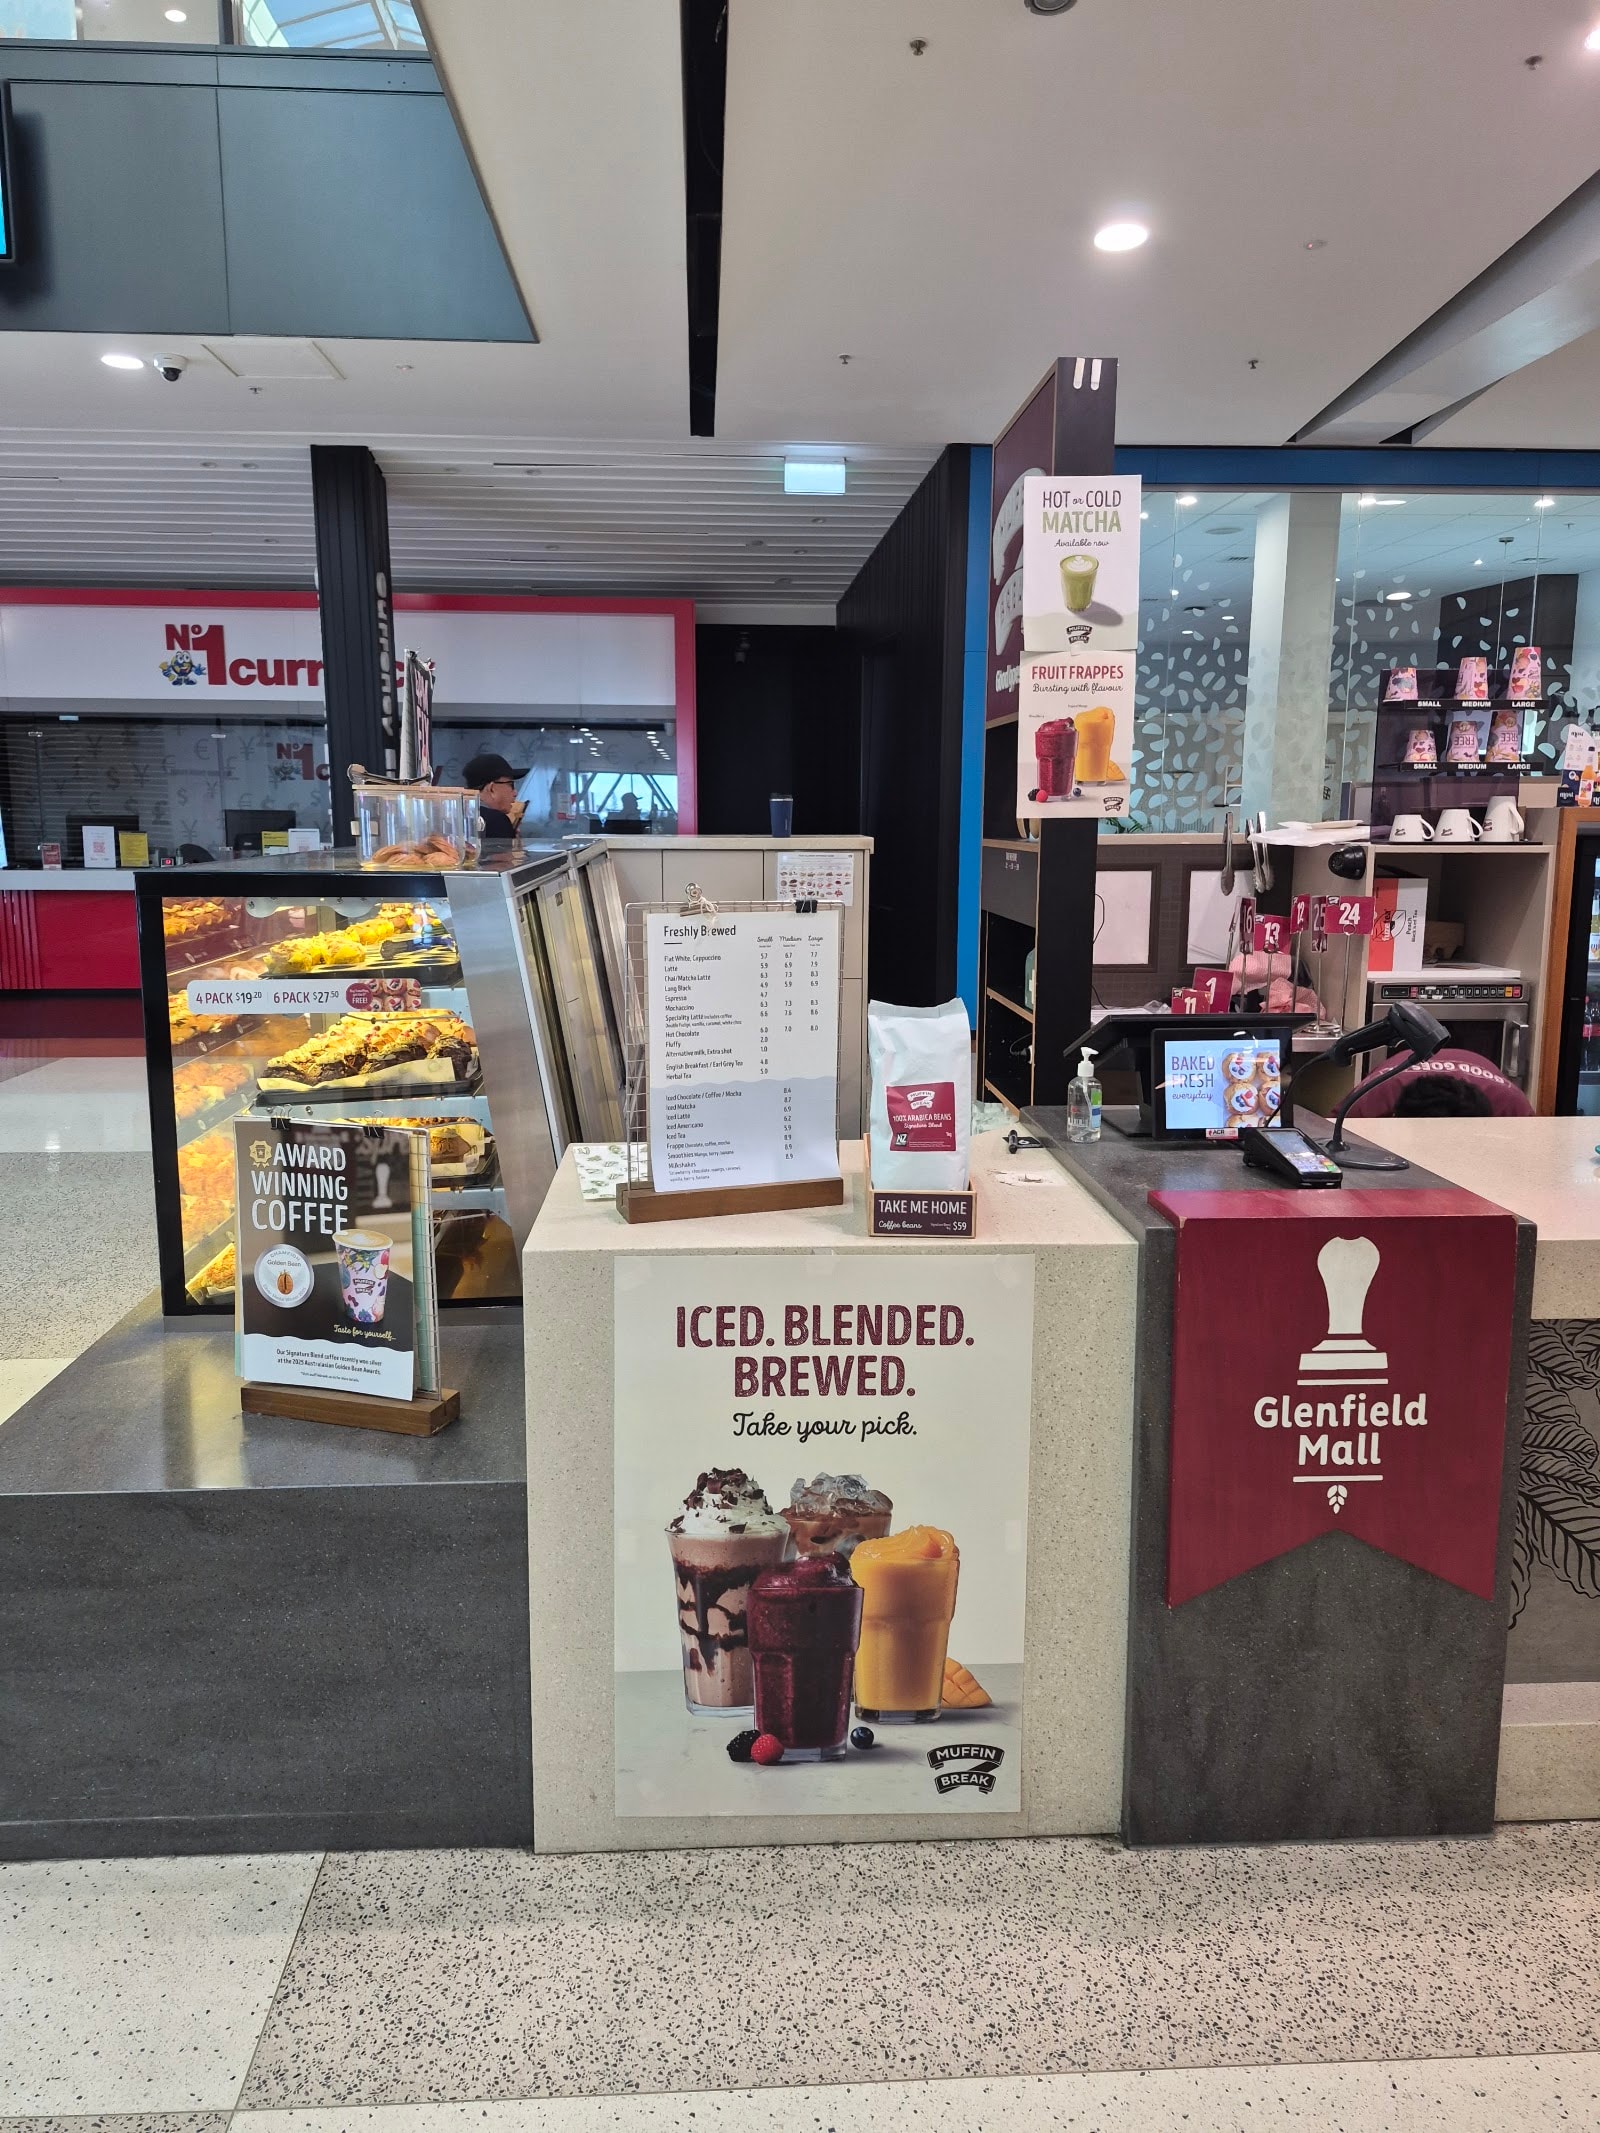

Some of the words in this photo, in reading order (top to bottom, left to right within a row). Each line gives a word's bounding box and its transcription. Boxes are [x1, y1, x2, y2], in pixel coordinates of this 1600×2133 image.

[1042, 490, 1070, 509] HOT
[1072, 497, 1085, 505] or
[1086, 490, 1122, 508] COLD
[1042, 510, 1122, 534] MATCHA
[1054, 539, 1092, 547] Available
[1032, 666, 1067, 680] FRUIT
[1069, 665, 1124, 680] FRAPPES
[1033, 683, 1069, 695] Bursting
[1071, 683, 1090, 692] with
[1091, 684, 1123, 695] flavour
[1339, 903, 1360, 925] 24
[664, 925, 698, 940] Freshly
[1264, 922, 1281, 944] 13
[196, 994, 204, 1004] 4
[205, 992, 233, 1004] PACK
[235, 991, 262, 1004] $19.20
[273, 994, 281, 1004] 6
[282, 991, 310, 1004] PACK
[313, 991, 340, 1003] $27.50
[1206, 977, 1217, 1005] 1
[665, 995, 687, 1003] Espresso
[665, 1014, 689, 1022] Speciality
[666, 1063, 684, 1072] English
[1171, 1056, 1215, 1071] BAKED
[1172, 1073, 1214, 1088] FRESH
[1172, 1090, 1213, 1102] everyday
[933, 1113, 952, 1121] BEANS
[272, 1143, 347, 1171] AWARD
[251, 1170, 348, 1200] WINNING
[878, 1200, 907, 1214] TAKE
[910, 1201, 929, 1214] ME
[931, 1201, 967, 1215] HOME
[251, 1199, 348, 1235] COFFEE
[878, 1220, 901, 1230] Coffee
[901, 1221, 923, 1229] beans
[953, 1221, 967, 1231] $59
[333, 1325, 352, 1334] Taste
[352, 1327, 364, 1337] for
[676, 1305, 775, 1348] ICED.
[784, 1304, 975, 1347] BLENDED.
[734, 1355, 916, 1398] BREWED.
[1254, 1393, 1428, 1428] Glenfield
[732, 1412, 792, 1437] Take
[796, 1419, 857, 1443] your
[861, 1412, 918, 1442] pick.
[1298, 1432, 1381, 1466] Mall
[936, 1747, 996, 1760] MUFFIN
[941, 1773, 990, 1786] BREAK
